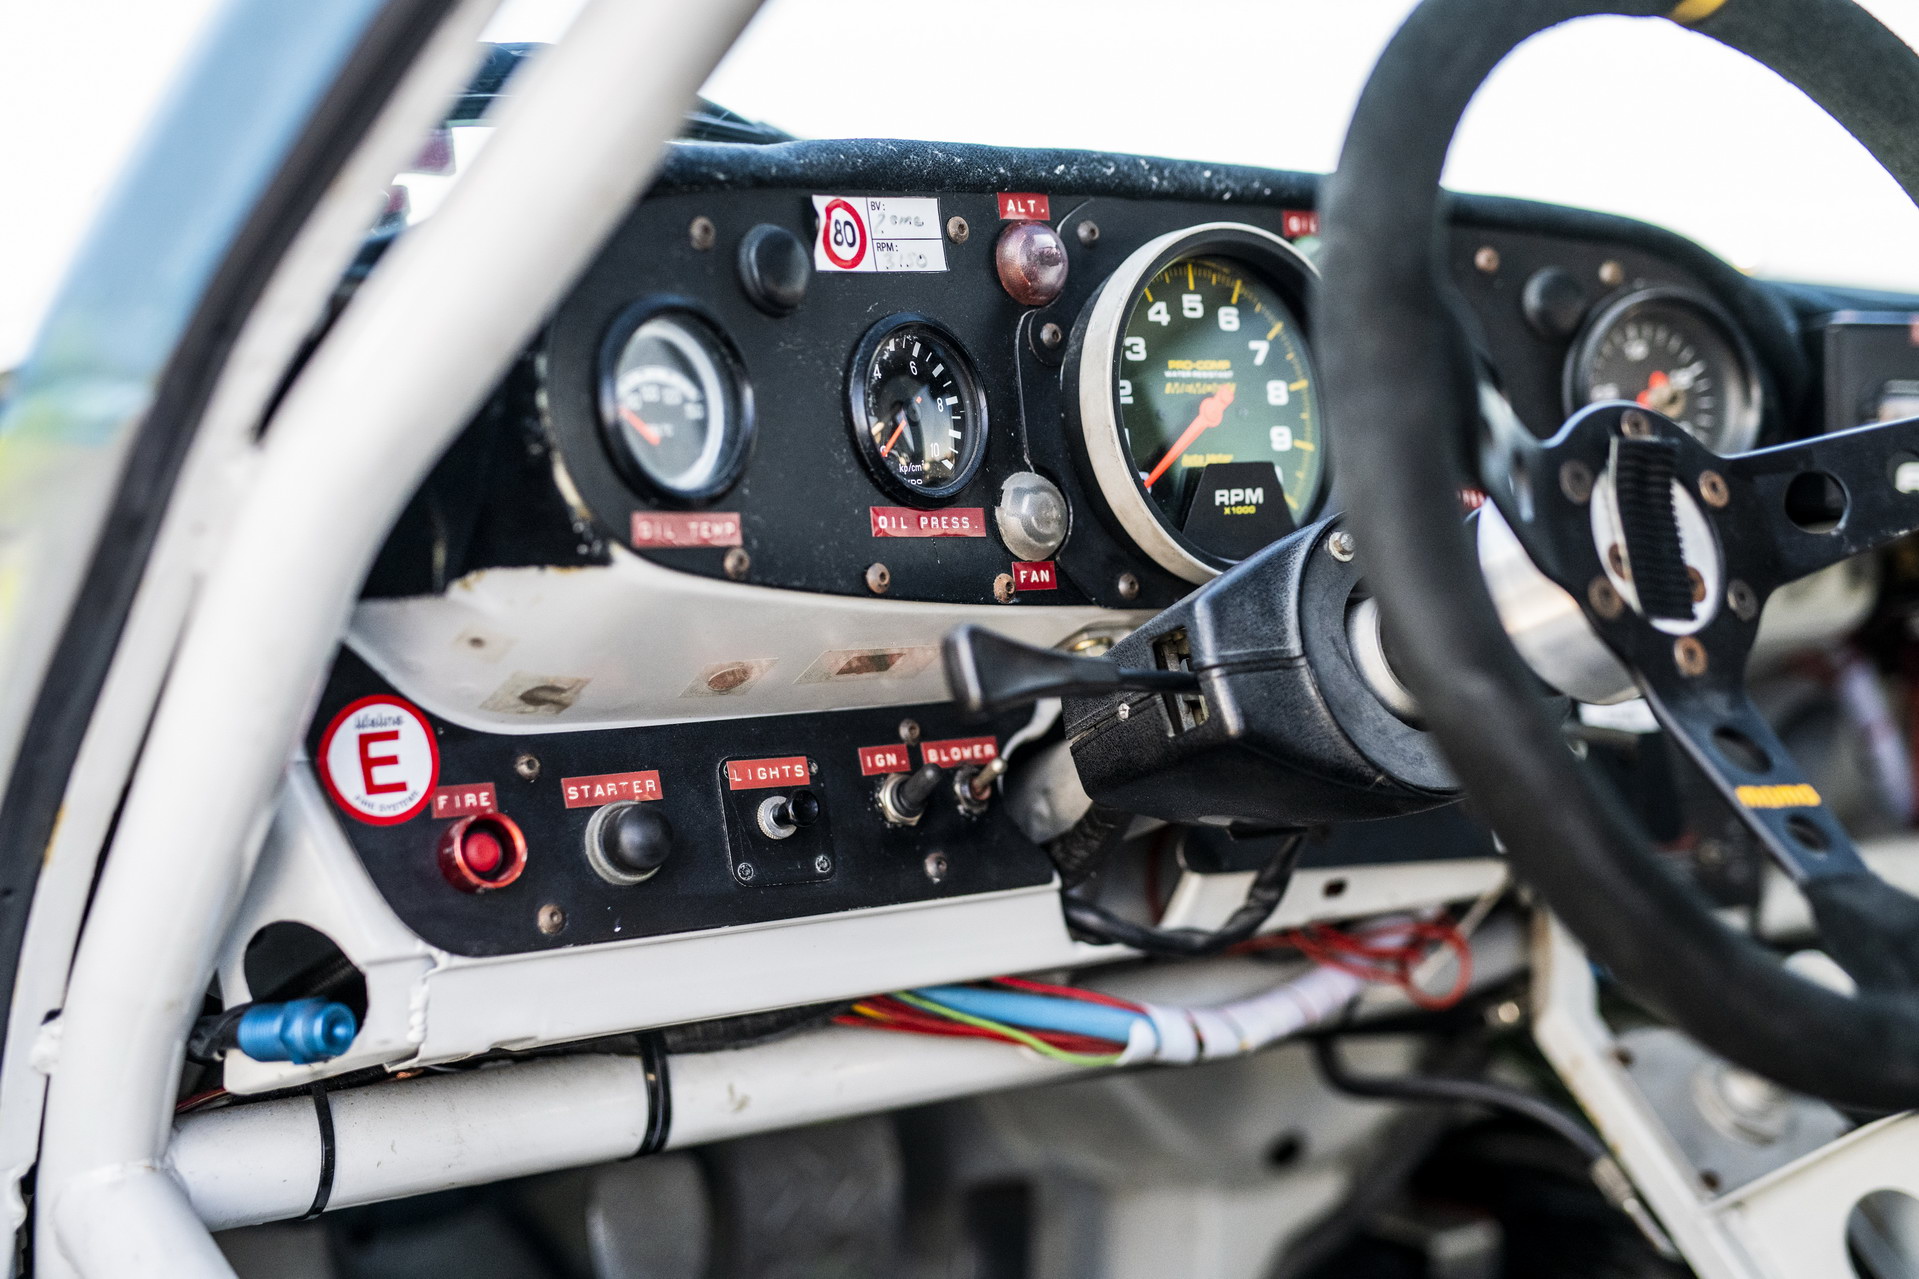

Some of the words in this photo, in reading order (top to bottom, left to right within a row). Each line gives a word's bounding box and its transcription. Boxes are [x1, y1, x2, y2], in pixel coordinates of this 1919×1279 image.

[870, 201, 886, 212] BV:
[1006, 198, 1045, 213] ALT.
[833, 219, 856, 248] 80
[876, 242, 899, 253] RPM:
[1147, 301, 1171, 326] 4
[1181, 293, 1204, 319] 5
[1217, 306, 1240, 332] 6
[1124, 336, 1147, 361] 3
[1248, 340, 1270, 366] 7
[873, 363, 882, 379] 4
[909, 360, 918, 376] 6
[1266, 379, 1289, 406] 8
[936, 397, 944, 412] 8
[1269, 425, 1293, 451] 9
[930, 442, 940, 457] 10
[1214, 487, 1264, 506] RPM
[637, 520, 676, 541] OIL
[688, 520, 737, 539] TEMP
[878, 515, 908, 530] OIL
[920, 515, 980, 530] PRESS.
[1019, 567, 1051, 584] FAN
[358, 730, 408, 795] E
[866, 753, 907, 768] IGN.
[926, 743, 996, 763] BLOWER
[733, 764, 805, 782] LIGHTS
[567, 779, 657, 800] STARTER
[437, 791, 491, 811] FIRE
